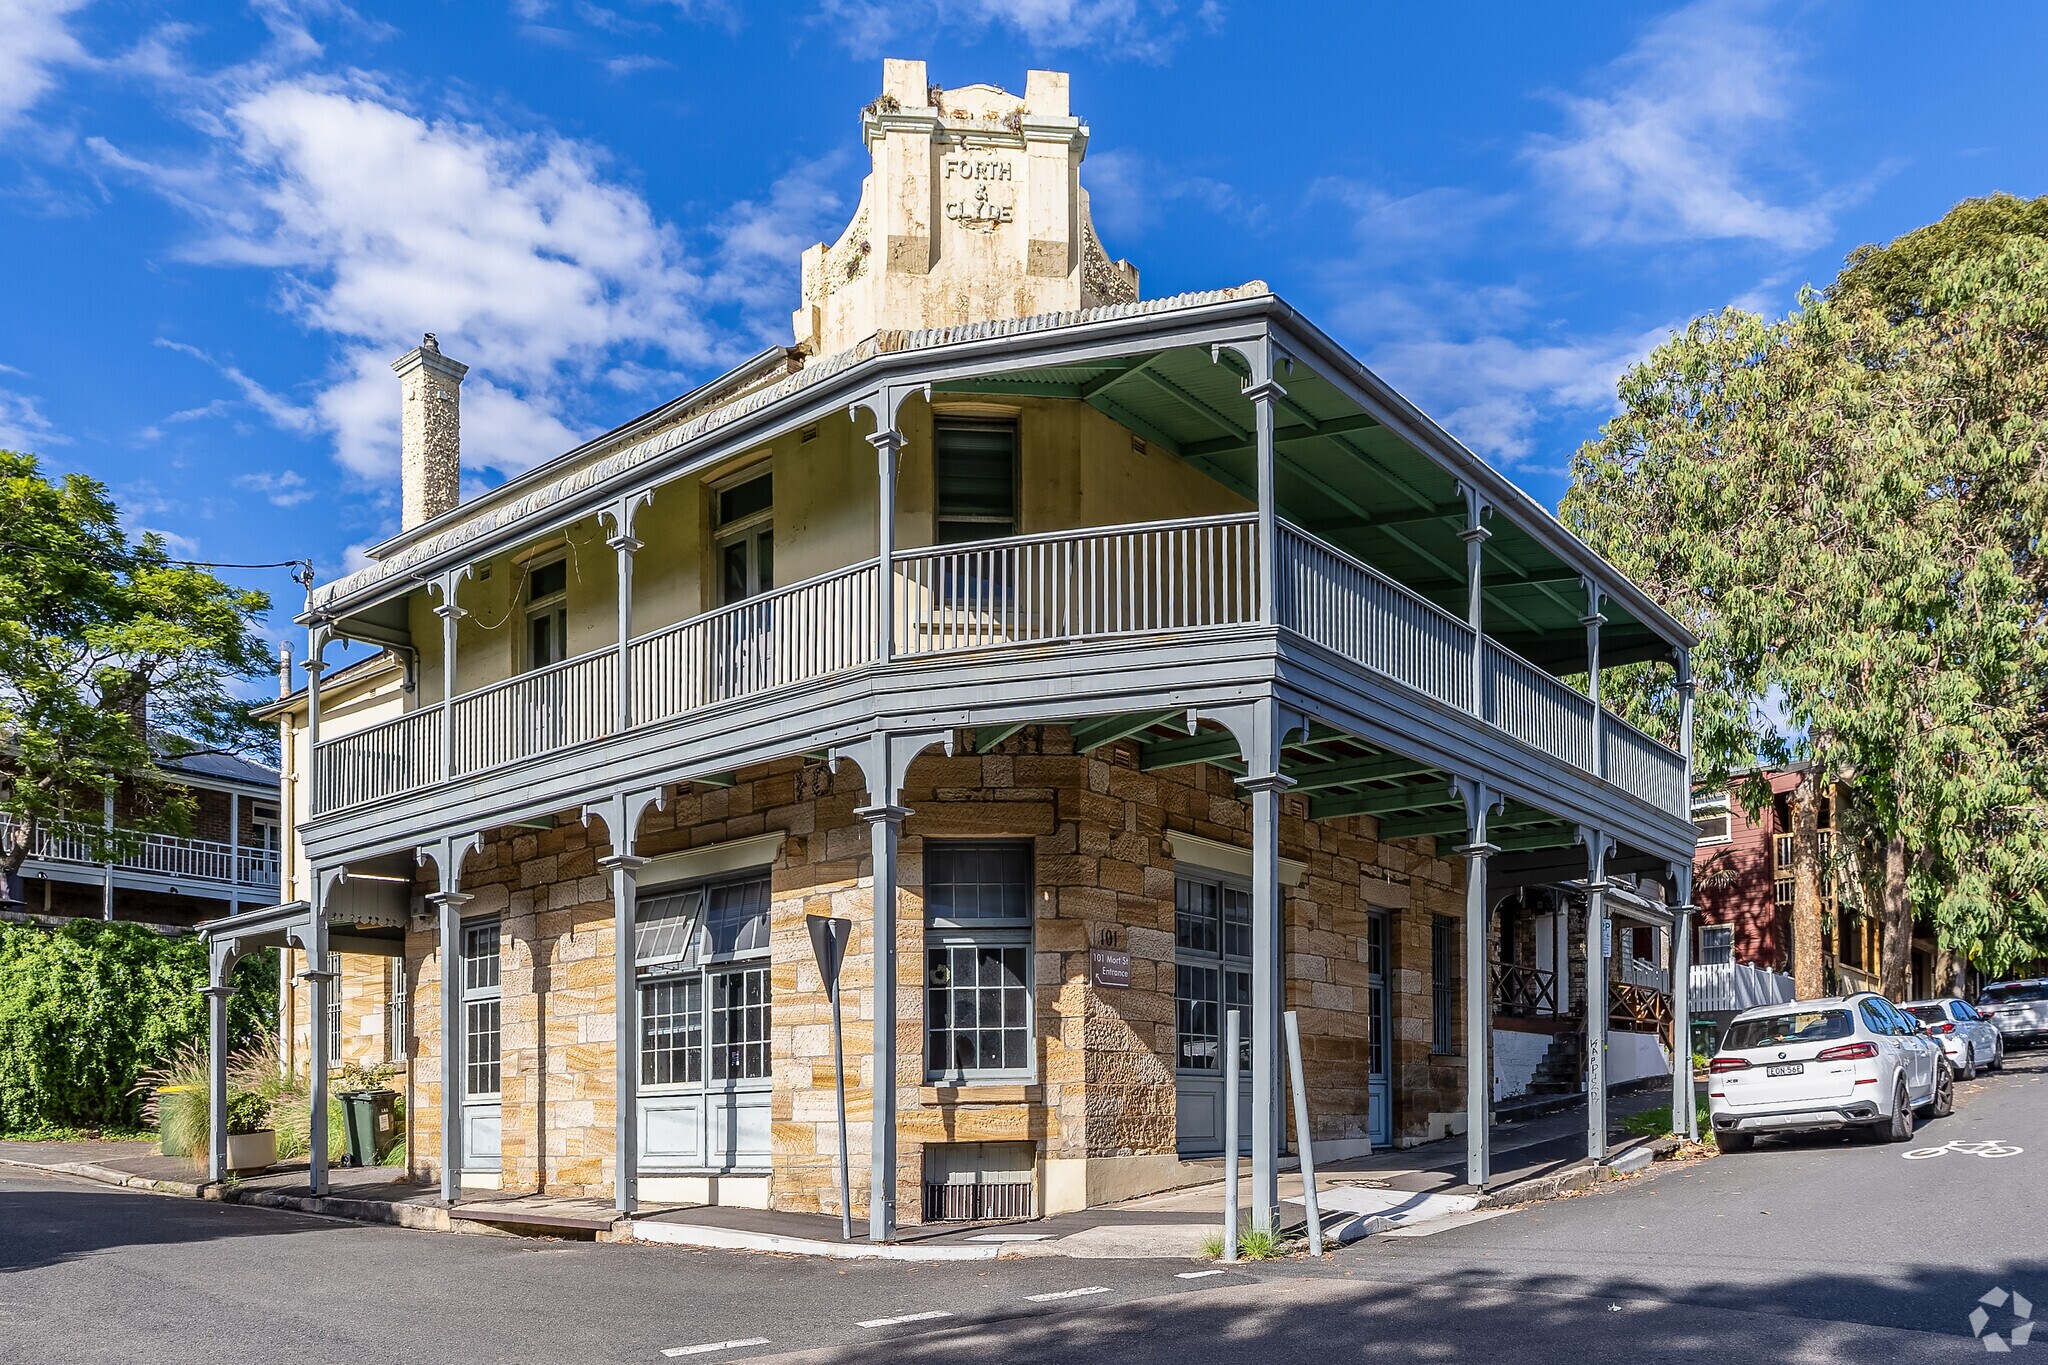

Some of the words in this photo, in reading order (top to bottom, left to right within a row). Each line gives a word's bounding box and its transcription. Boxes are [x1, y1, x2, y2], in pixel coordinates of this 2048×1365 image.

[944, 159, 1012, 181] FORTH
[974, 182, 989, 202] &
[945, 201, 1013, 223] CLYDE
[1100, 928, 1118, 947] 101
[1093, 953, 1104, 963] 101
[1106, 955, 1121, 965] Mort
[1122, 956, 1129, 965] St
[1102, 966, 1129, 978] Entrance
